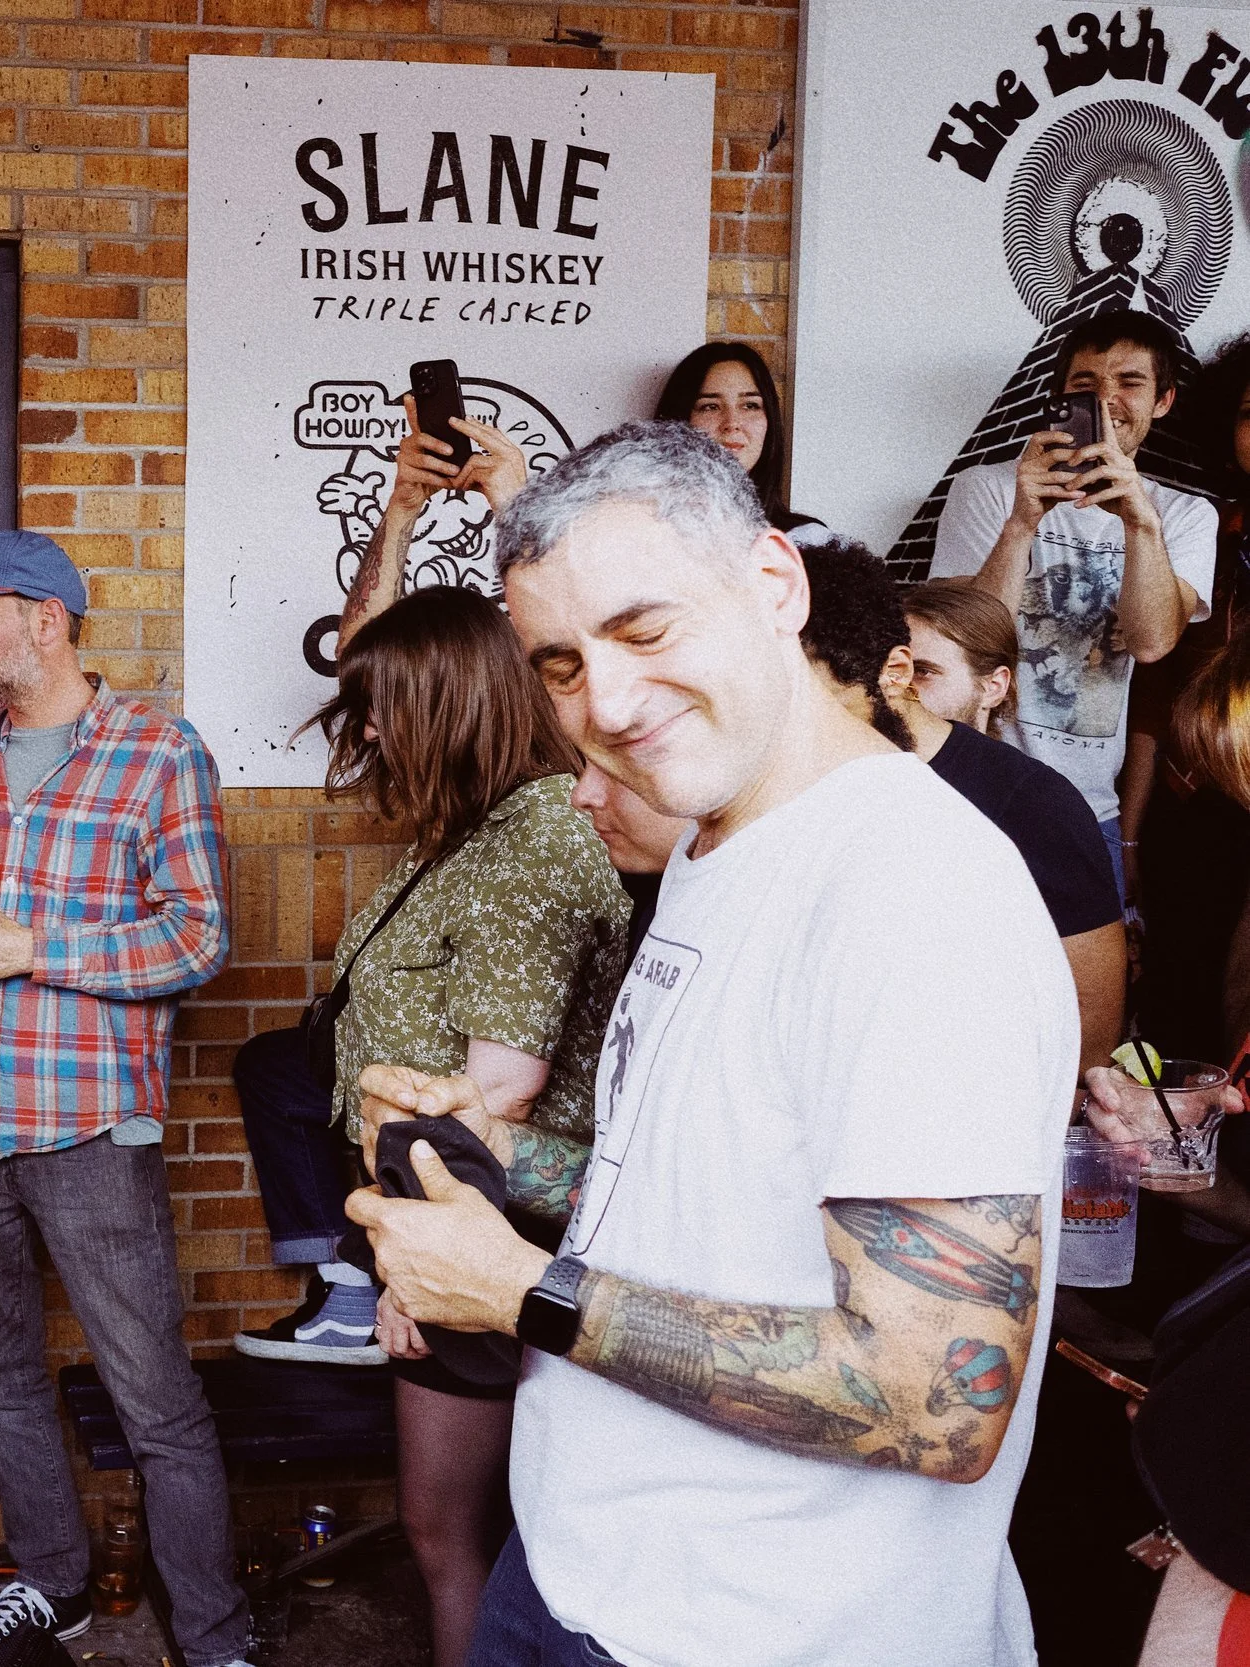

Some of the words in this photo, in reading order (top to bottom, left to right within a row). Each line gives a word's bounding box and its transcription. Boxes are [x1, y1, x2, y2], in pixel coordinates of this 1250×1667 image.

[928, 69, 1039, 182] The
[1035, 7, 1168, 97] 13th
[295, 131, 610, 240] SLANE
[300, 248, 406, 280] IRISH
[422, 250, 605, 286] WHISKEY
[312, 295, 440, 322] TRIPLE
[458, 297, 591, 325] CASKED
[322, 393, 375, 413] BOY
[305, 418, 406, 438] HOWDY!
[645, 958, 681, 990] ARAB
